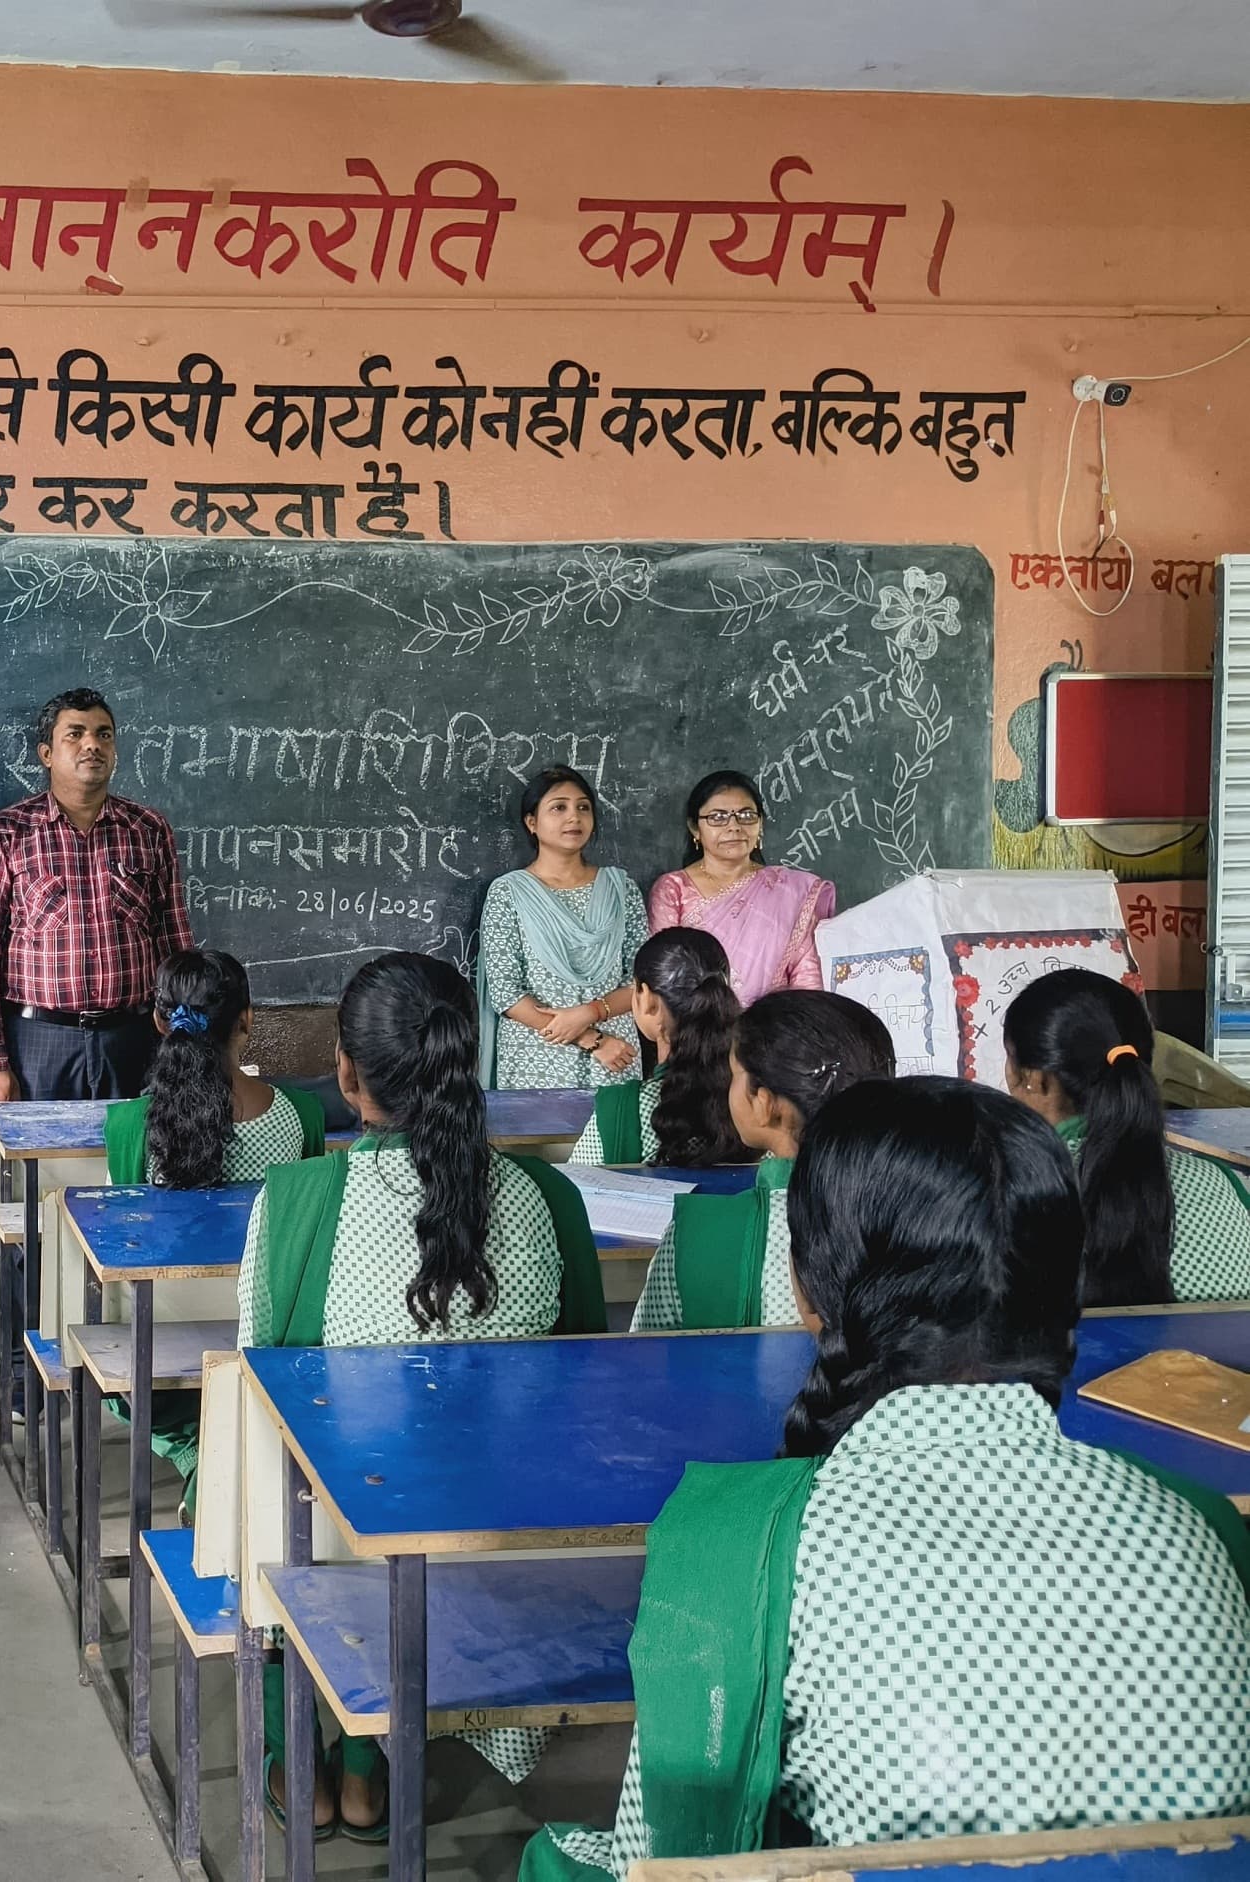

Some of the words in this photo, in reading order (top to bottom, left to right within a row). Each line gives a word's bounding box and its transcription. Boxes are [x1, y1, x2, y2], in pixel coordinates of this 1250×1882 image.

[47, 349, 237, 454] किसी
[245, 354, 399, 460] कार्य
[401, 356, 487, 452] को
[479, 359, 600, 459] नहीं
[771, 367, 903, 456] बल्कि
[909, 390, 1027, 482] बहुत
[32, 476, 148, 535] कर
[170, 480, 345, 539] करता
[295, 886, 438, 923] 28/06/2025
[1126, 893, 1158, 944] ही
